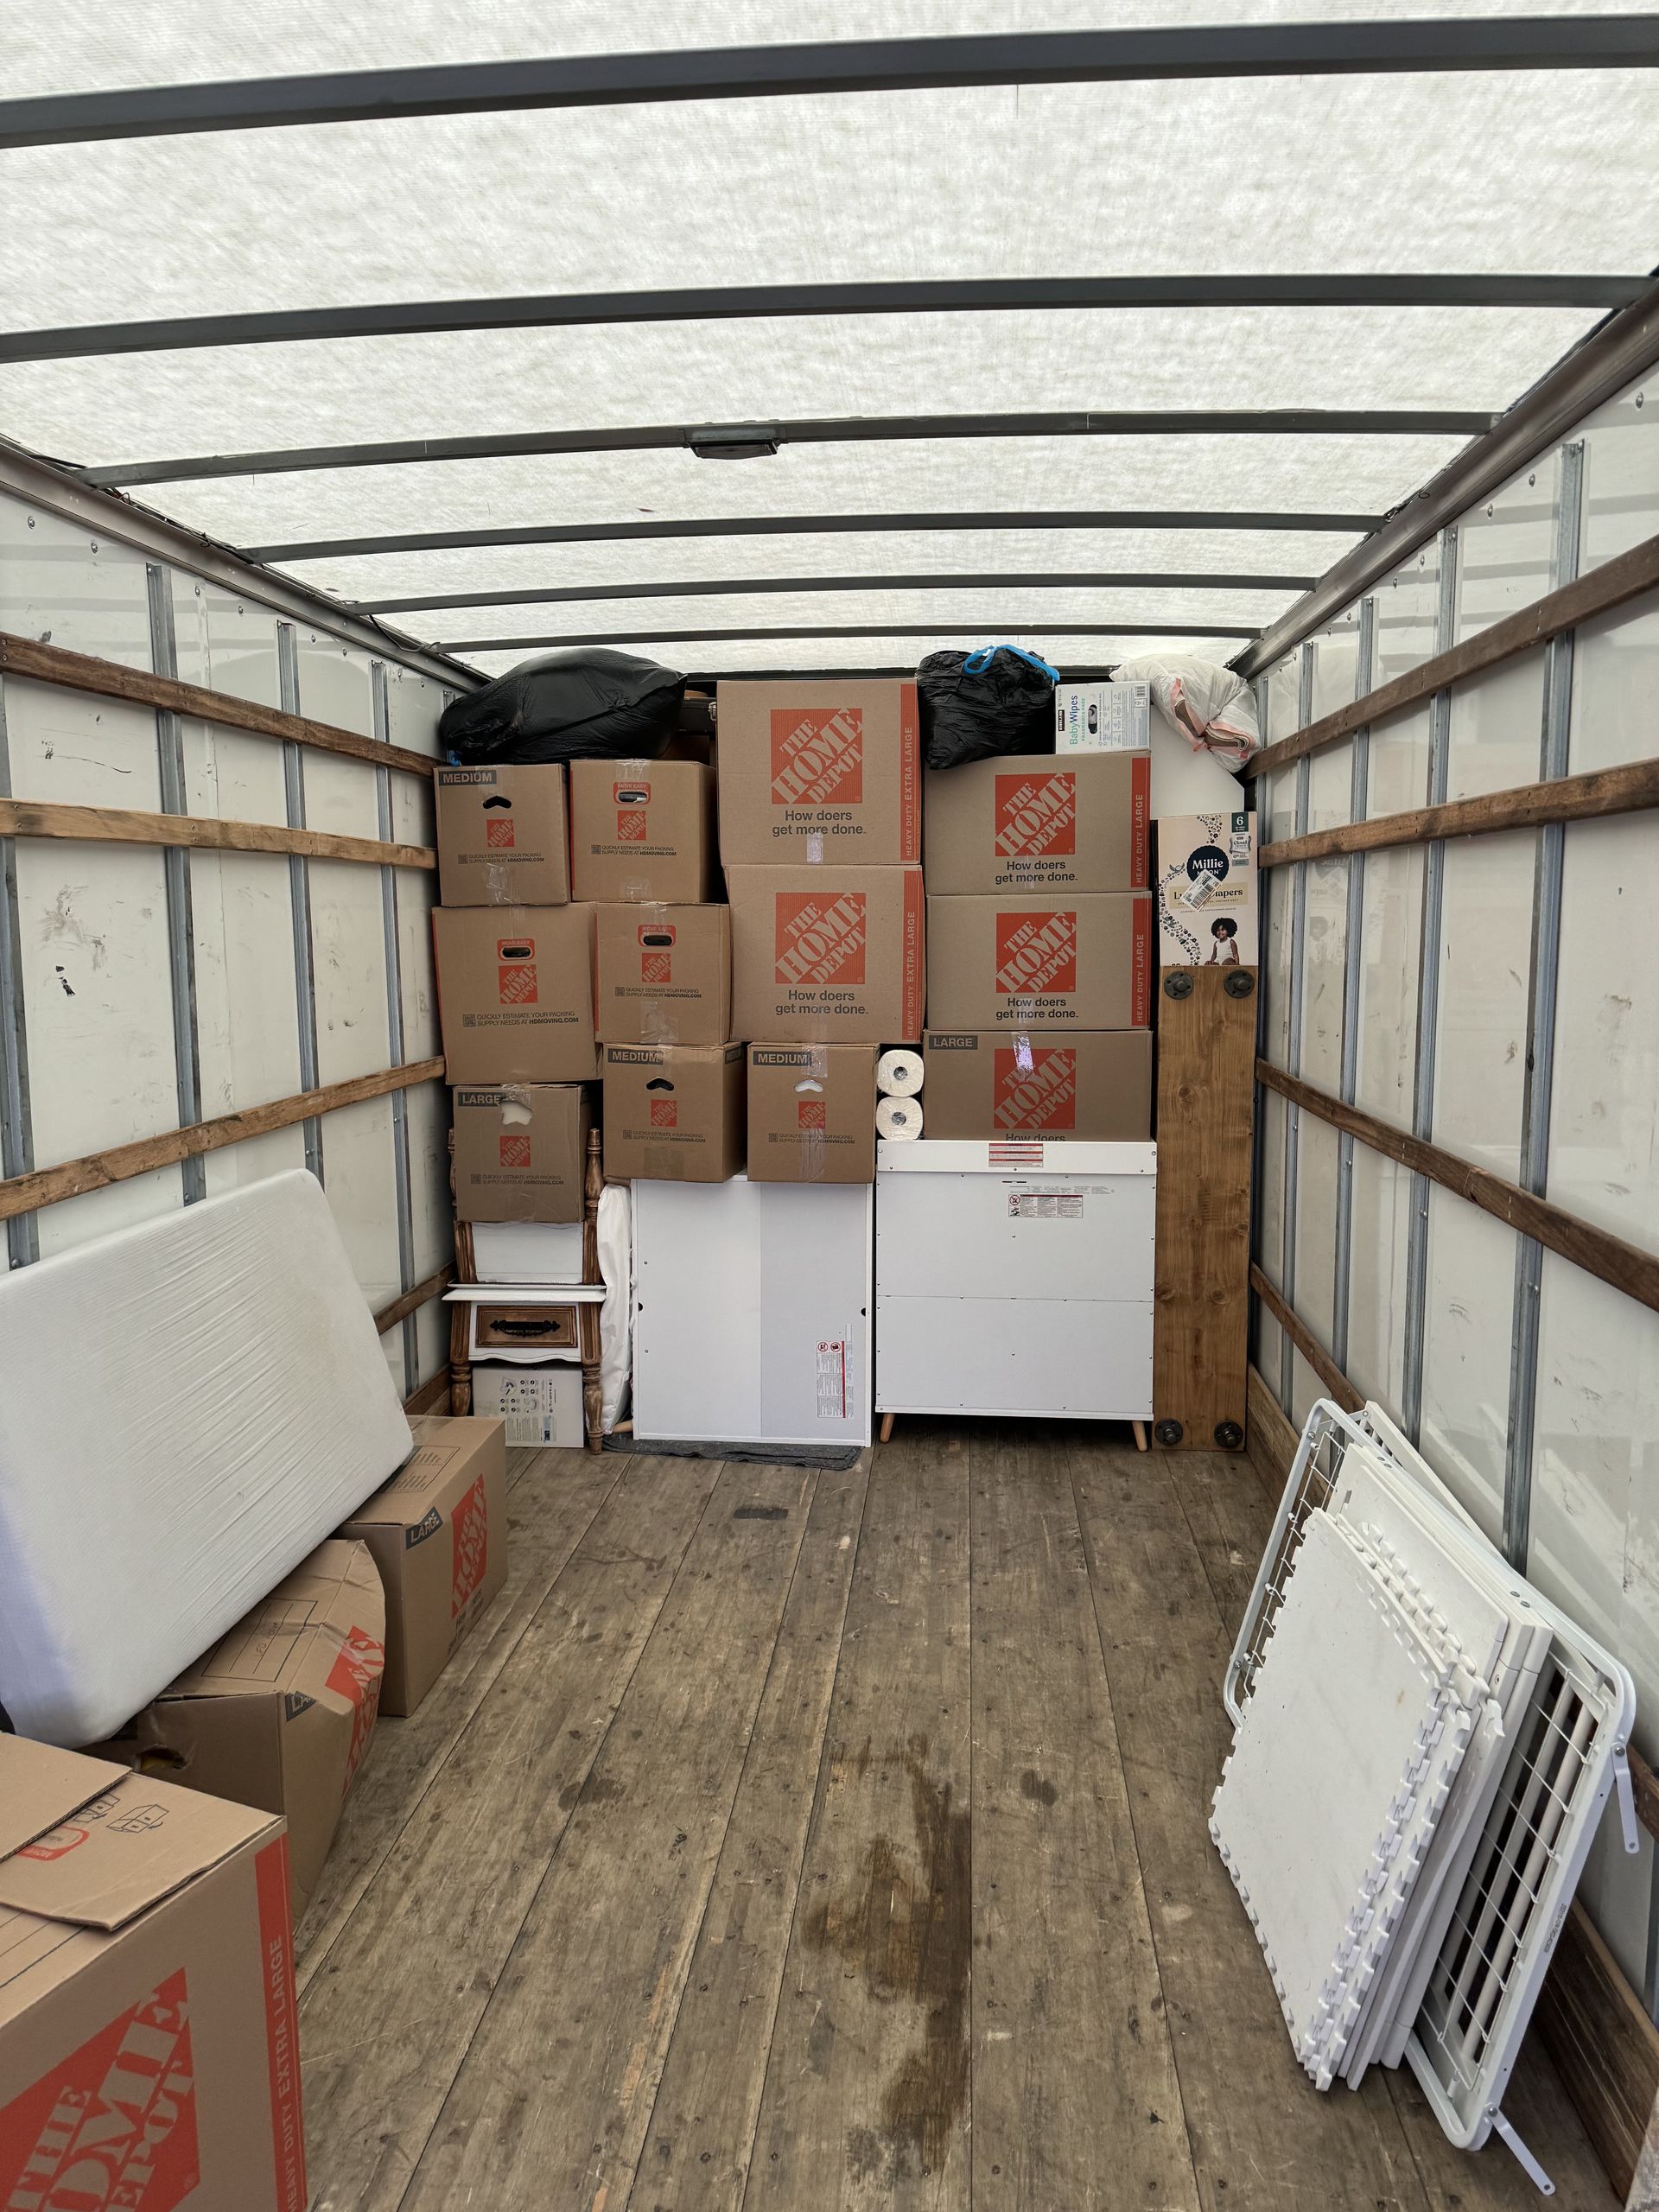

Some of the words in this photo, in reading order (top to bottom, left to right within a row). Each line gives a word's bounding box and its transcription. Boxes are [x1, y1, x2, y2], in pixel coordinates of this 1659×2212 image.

[1070, 696, 1080, 745] BabyWipes
[779, 719, 818, 757] THE
[772, 709, 863, 804] HOME
[442, 772, 493, 783] MEDIUM
[806, 743, 863, 804] DEPOT
[995, 772, 1076, 856] HOME
[1002, 782, 1036, 816] THE
[617, 810, 646, 841] HOME
[772, 825, 792, 837] get
[797, 826, 828, 835] more
[832, 823, 866, 835] done.
[785, 810, 813, 821] How
[817, 810, 853, 821] doers
[1027, 803, 1075, 855] DEPOT
[1236, 817, 1243, 826] 6
[629, 823, 646, 840] DEPOT
[995, 874, 1013, 885] get
[1047, 872, 1077, 881] done.
[1007, 861, 1031, 871] How
[1034, 861, 1066, 870] doers
[1192, 859, 1224, 869] Millie
[784, 901, 822, 938] THE
[775, 893, 866, 984] HOME
[1003, 920, 1037, 953] THE
[642, 953, 671, 982] HOME
[810, 926, 866, 983] DEPOT
[996, 912, 1077, 993] HOME
[1027, 942, 1076, 993] DEPOT
[501, 964, 537, 1004] HOME
[504, 969, 518, 985] THE
[515, 980, 537, 1003] DEPOT
[775, 1004, 796, 1015] get
[799, 1005, 830, 1014] more
[835, 1004, 868, 1014] done.
[788, 990, 816, 1001] How
[819, 990, 855, 1001] doers
[1007, 998, 1032, 1007] How
[1035, 998, 1066, 1007] doers
[996, 1010, 1014, 1020] get
[1048, 1009, 1078, 1019] done.
[612, 1051, 659, 1062] MEDIUM
[933, 1038, 973, 1047] LARGE
[758, 1053, 808, 1064] MEDIUM
[462, 1095, 499, 1104] LARGE
[994, 1049, 1076, 1128] HOME
[1026, 1078, 1075, 1128] DEPOT
[651, 1099, 677, 1127] HOME
[798, 1102, 826, 1128] HOME
[500, 1136, 531, 1166] HOME
[410, 1512, 439, 1543] LARGE
[270, 1935, 285, 2017] LARGE
[276, 2018, 291, 2099] EXTRA
[282, 2101, 293, 2152] DUTY
[286, 2157, 298, 2212] HEAVY
